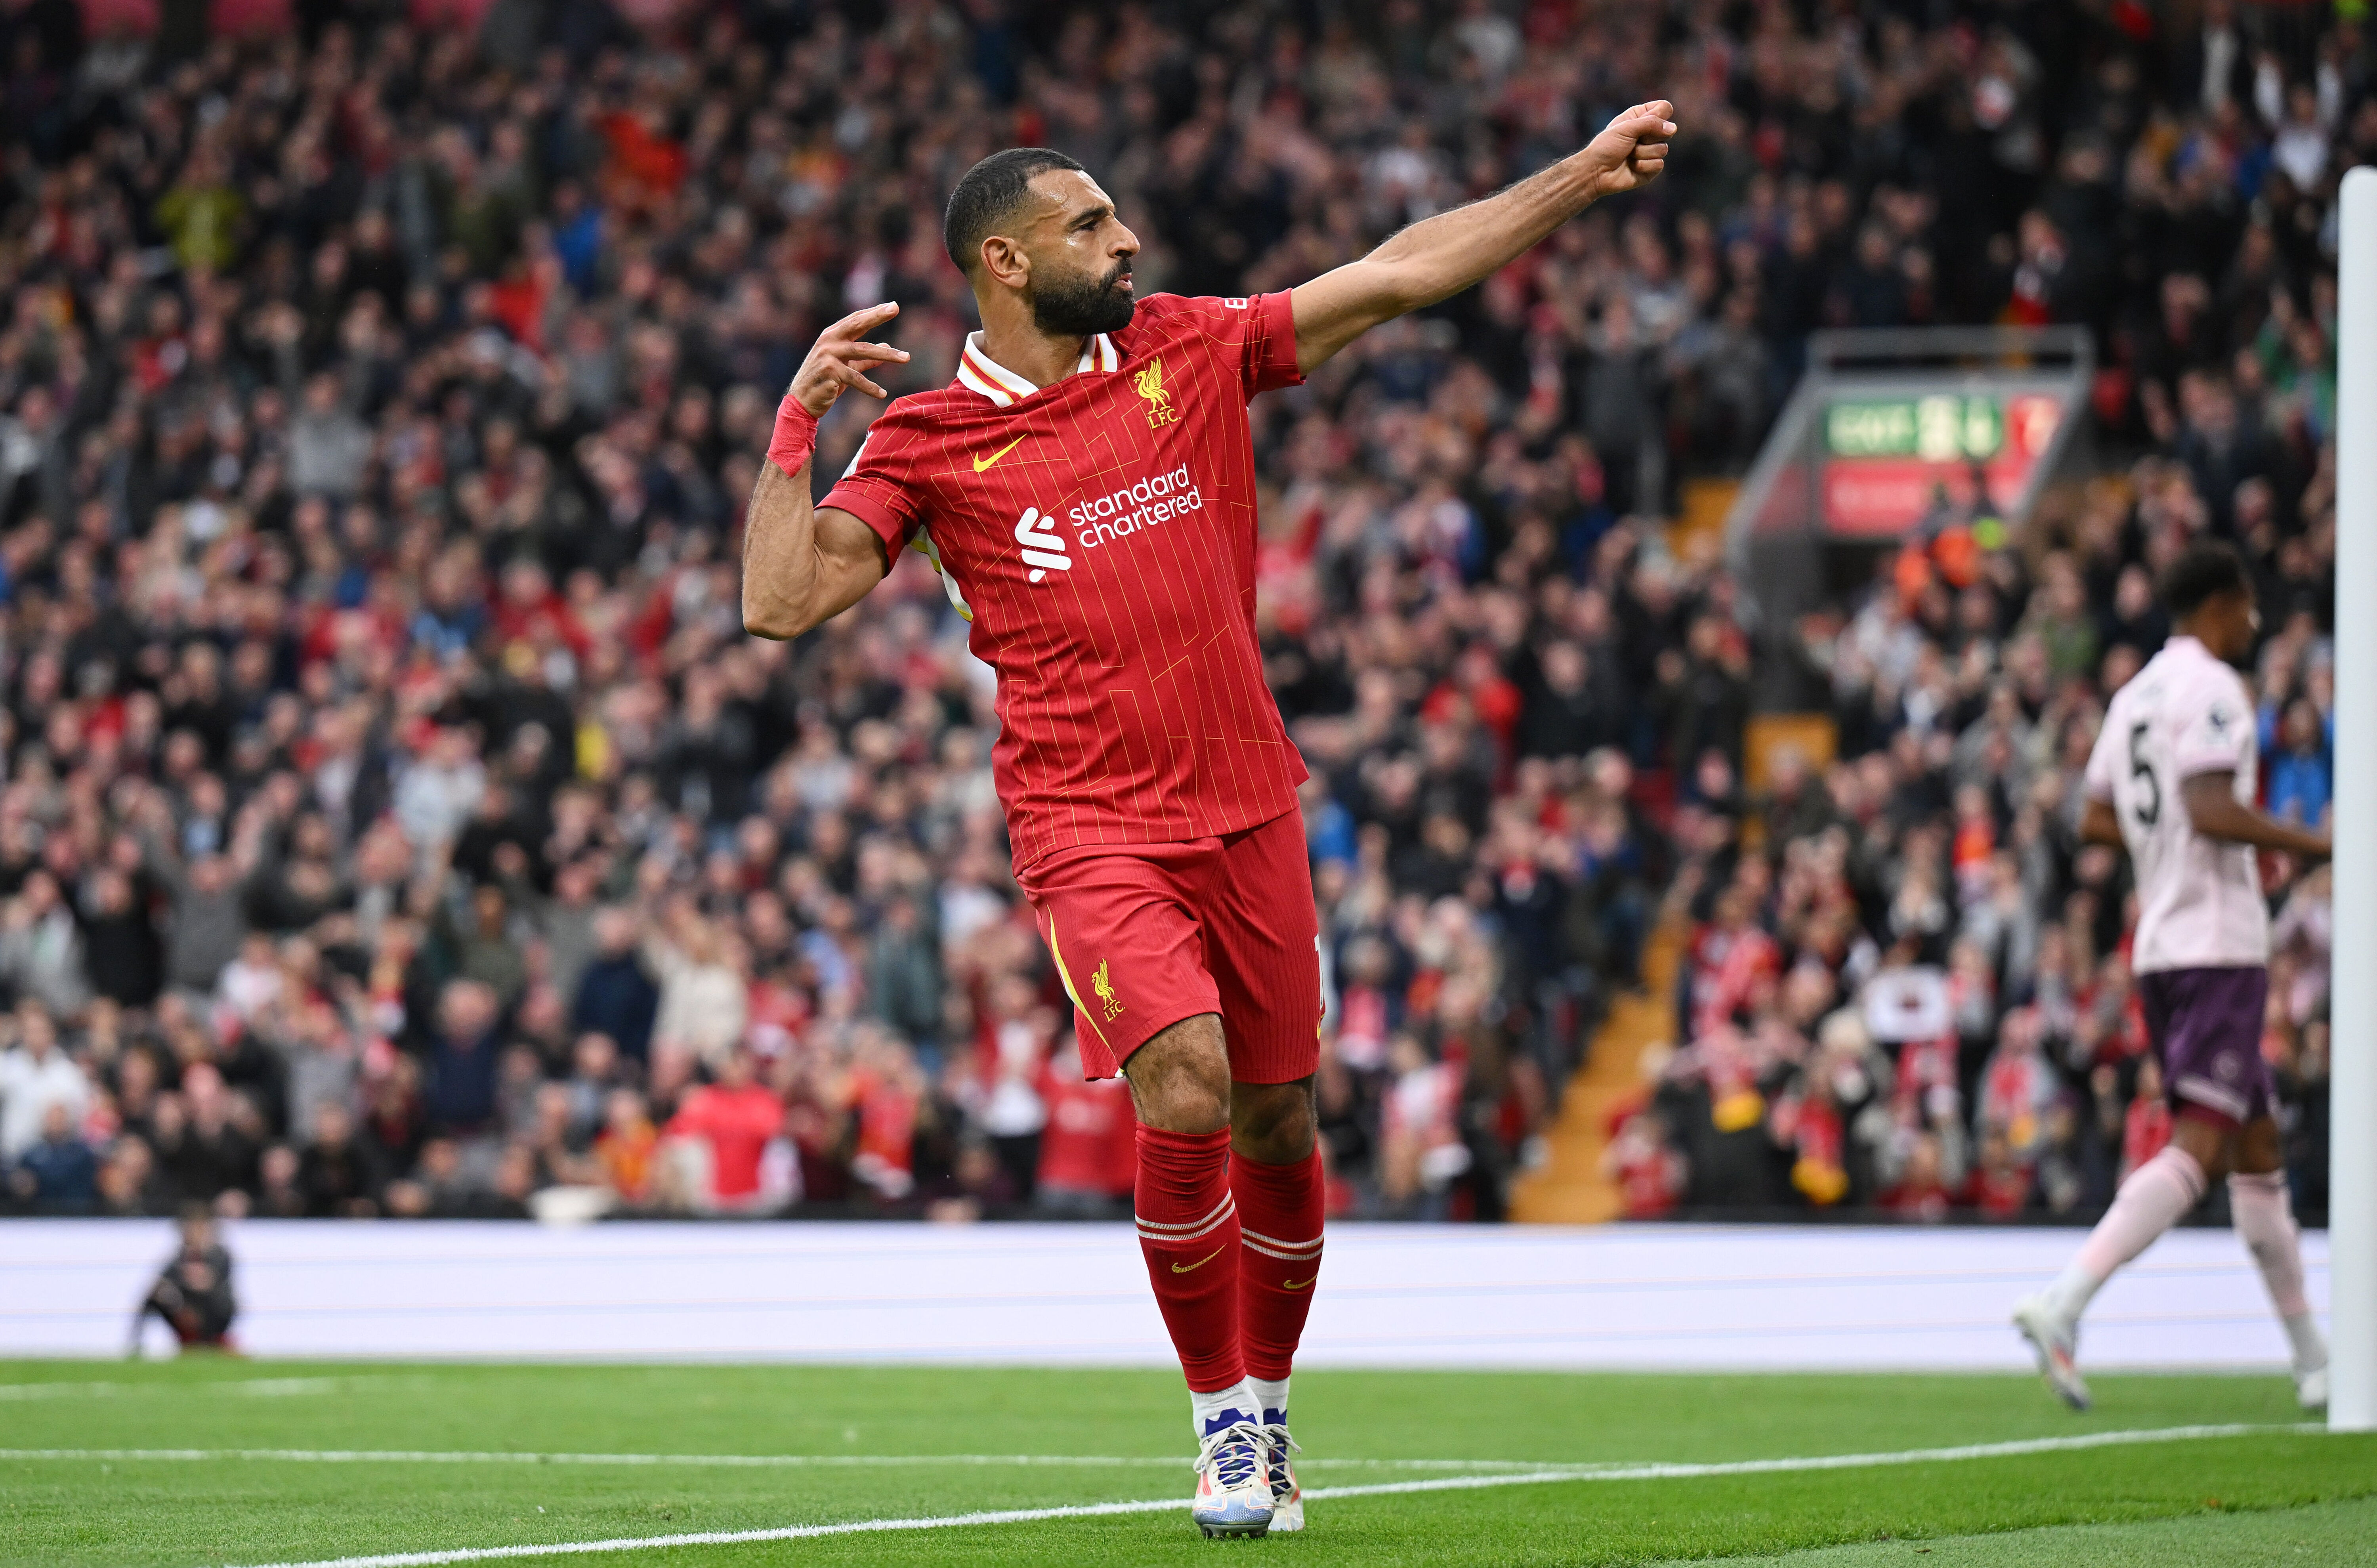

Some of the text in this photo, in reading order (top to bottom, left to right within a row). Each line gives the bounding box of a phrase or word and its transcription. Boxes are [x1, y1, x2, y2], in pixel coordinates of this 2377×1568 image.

[1147, 408, 1181, 429] L.F.C.
[1069, 462, 1189, 527] standard
[1079, 485, 1203, 548] chartered
[2129, 719, 2161, 826] 5
